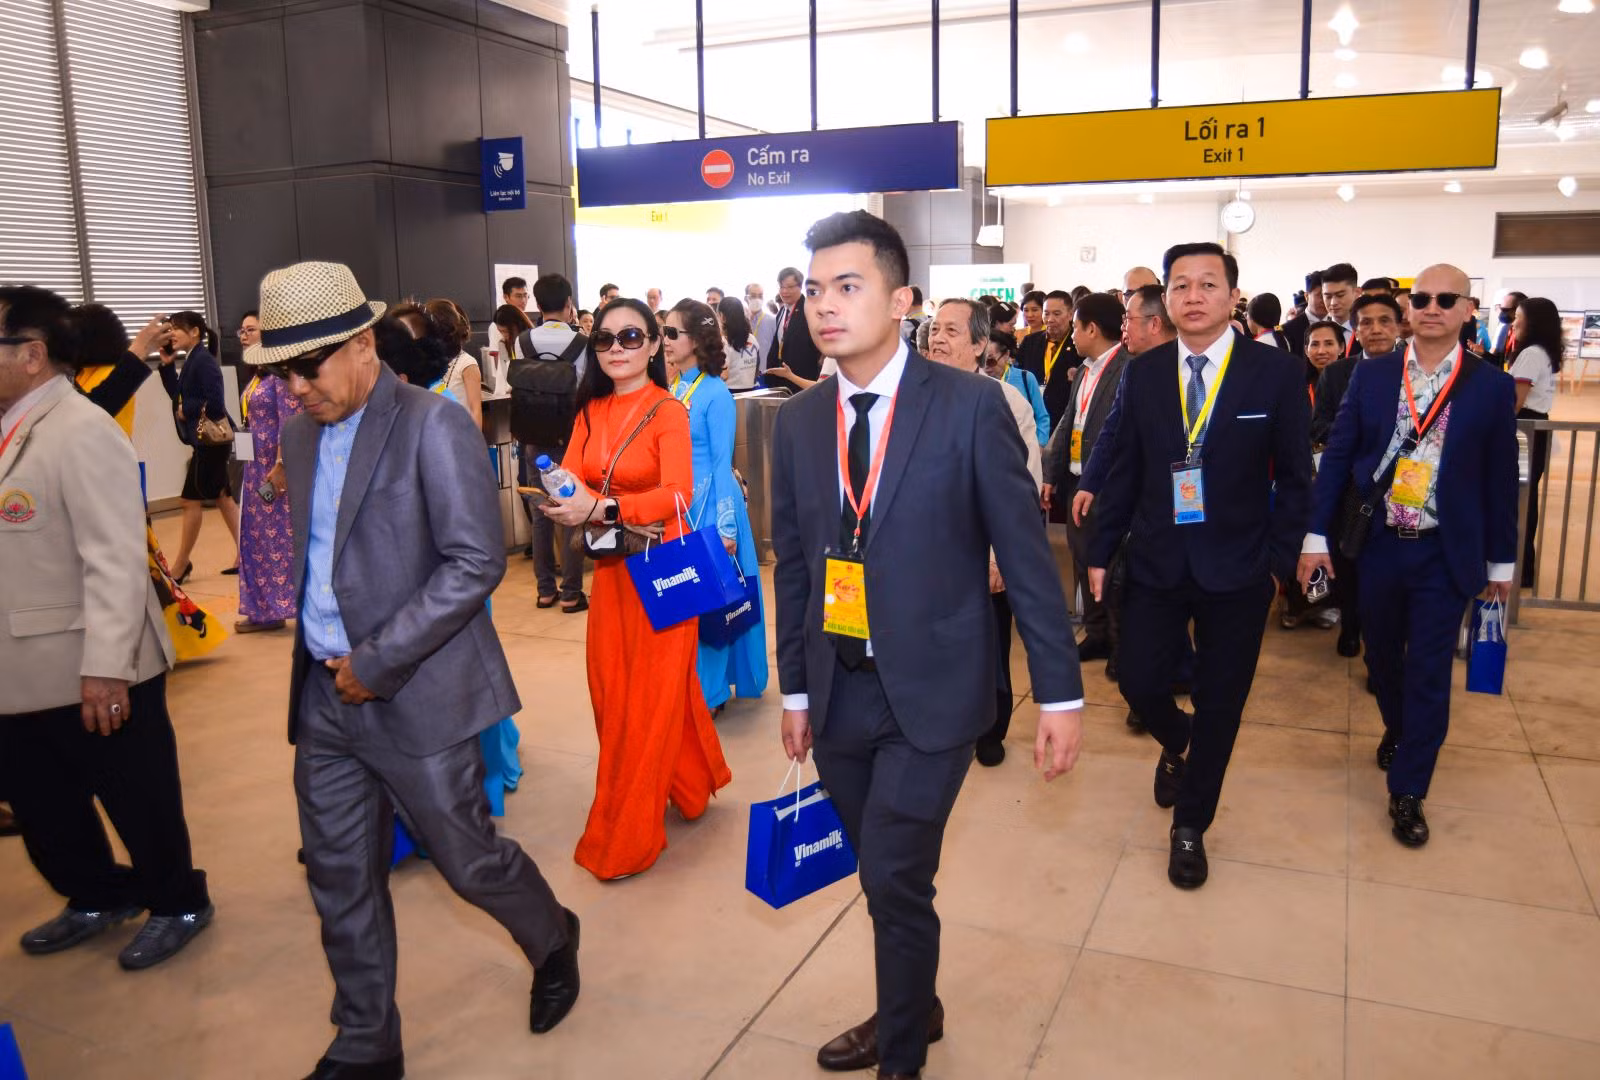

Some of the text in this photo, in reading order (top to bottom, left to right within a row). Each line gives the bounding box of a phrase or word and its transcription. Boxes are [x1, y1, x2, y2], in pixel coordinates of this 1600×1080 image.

[1184, 116, 1264, 141] Lối ra 1
[747, 144, 809, 166] Cấm ra
[1203, 147, 1243, 163] Exit 1
[747, 171, 790, 185] No Exit
[652, 566, 699, 592] Vinamilk
[725, 600, 751, 622] Vinamilk
[794, 829, 842, 861] Vinamilk
